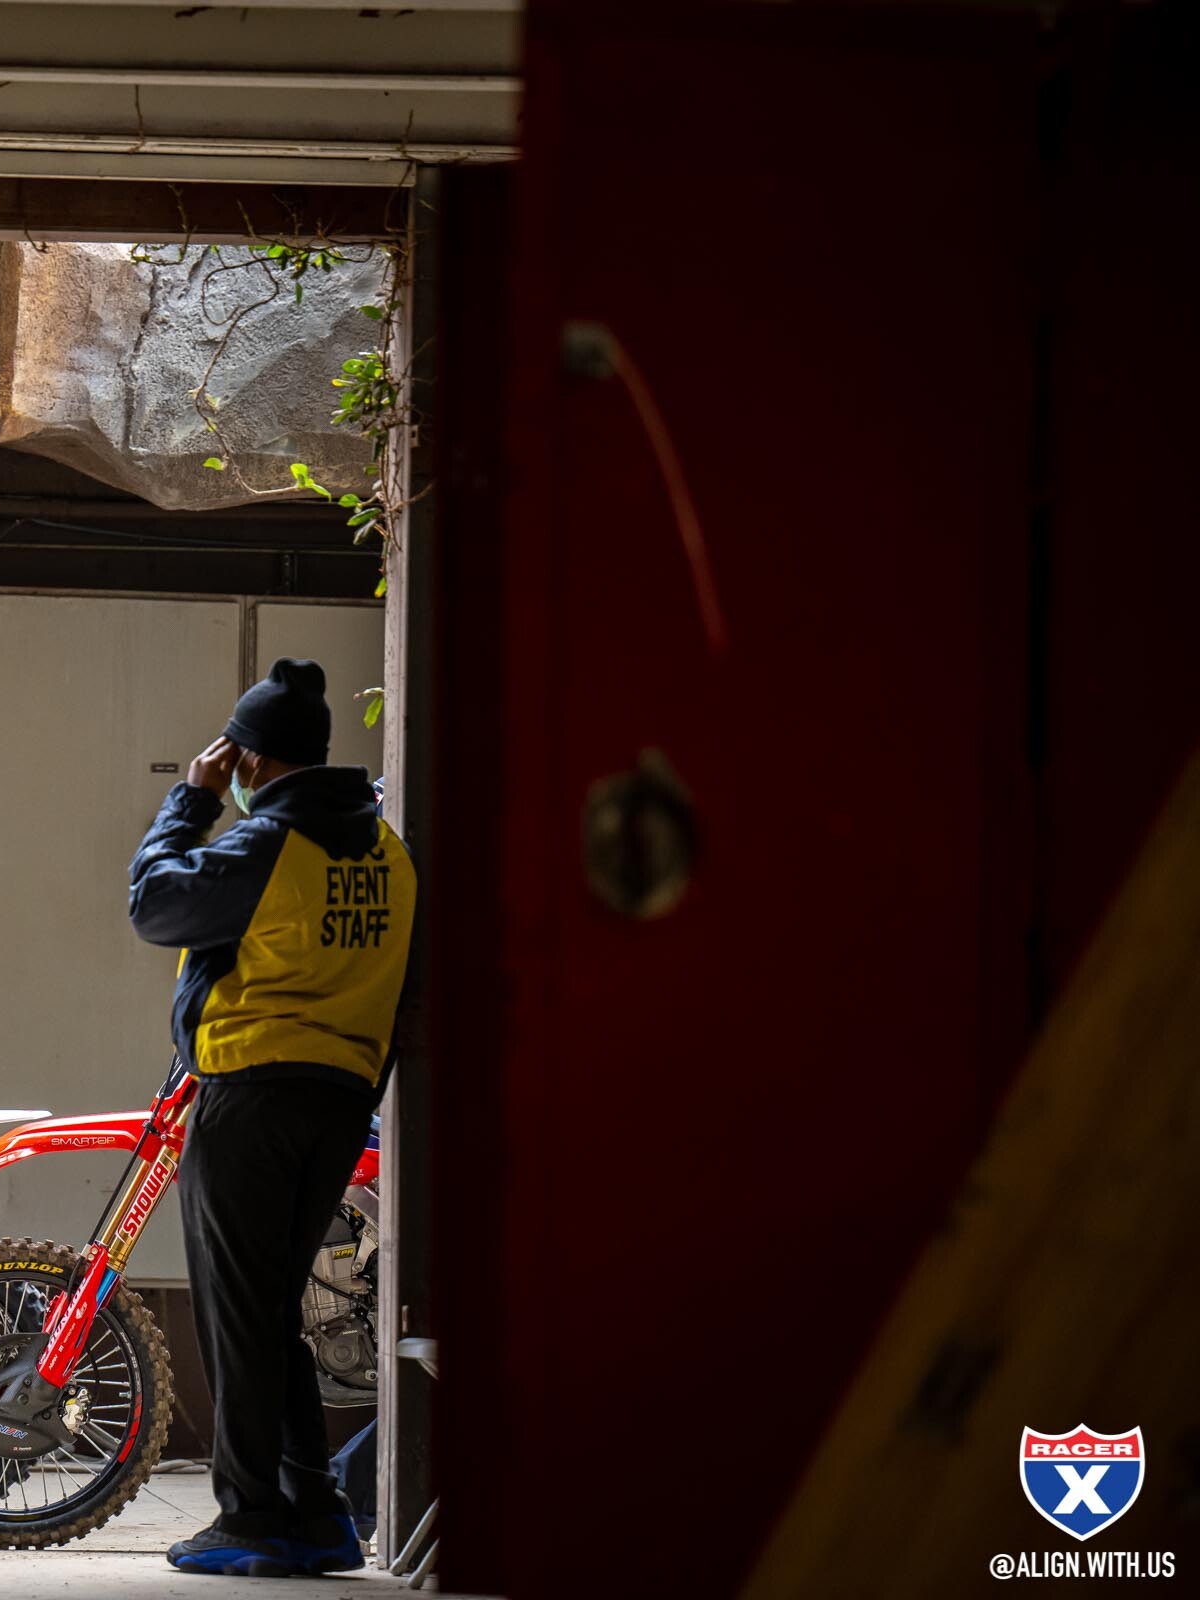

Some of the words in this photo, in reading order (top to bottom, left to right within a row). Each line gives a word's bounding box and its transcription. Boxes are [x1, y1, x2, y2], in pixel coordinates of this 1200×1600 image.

[326, 866, 390, 905] EVENT
[321, 909, 390, 949] STAFF
[51, 1136, 116, 1146] SMARTOP
[122, 1160, 170, 1238] SHOWA
[335, 1249, 353, 1257] XPR
